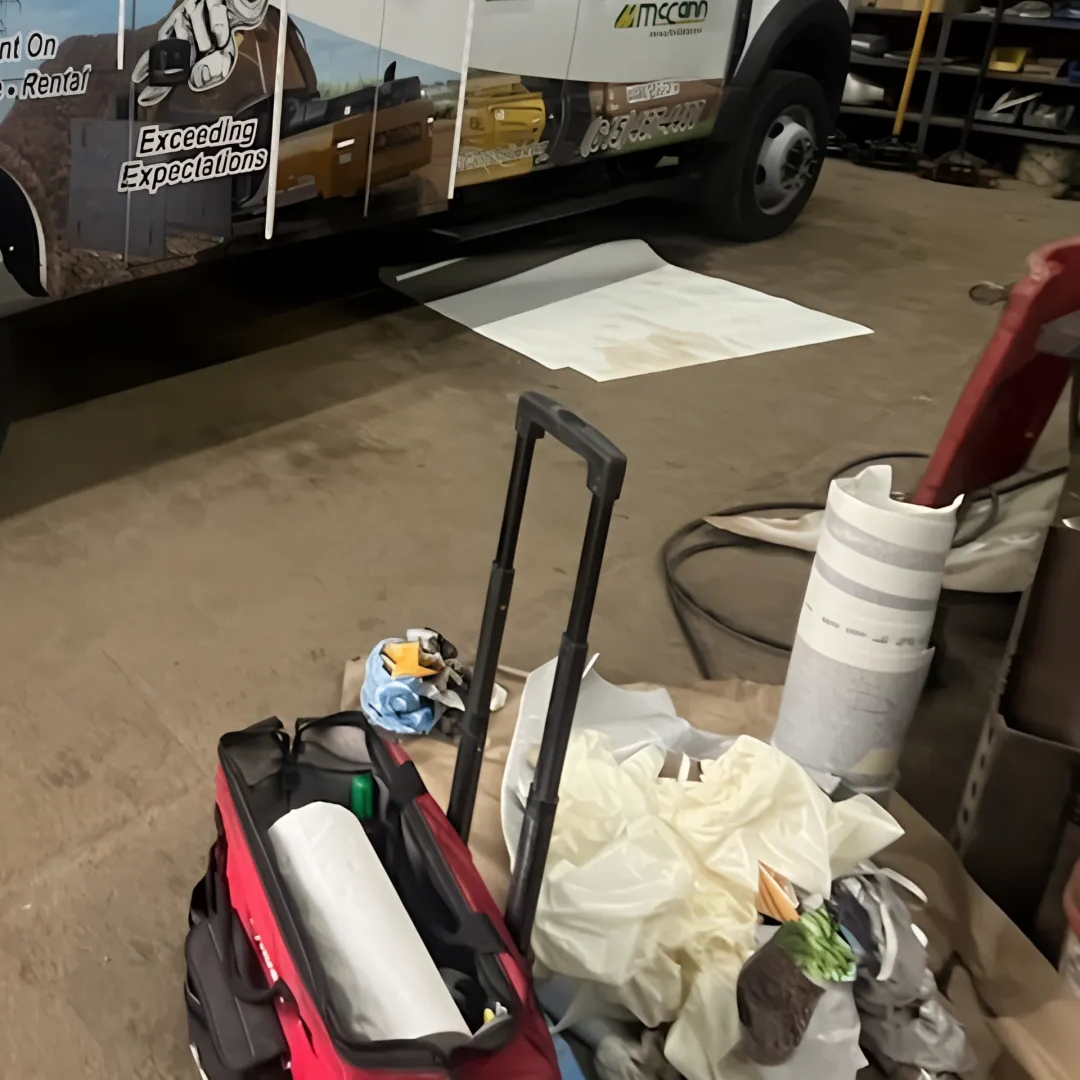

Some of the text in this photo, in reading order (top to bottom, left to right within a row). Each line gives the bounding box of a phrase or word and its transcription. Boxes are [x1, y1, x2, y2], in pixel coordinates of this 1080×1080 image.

[27, 32, 57, 60] On
[22, 67, 92, 98] Rental
[139, 118, 257, 154] Exceeding
[120, 149, 266, 191] Expectations
